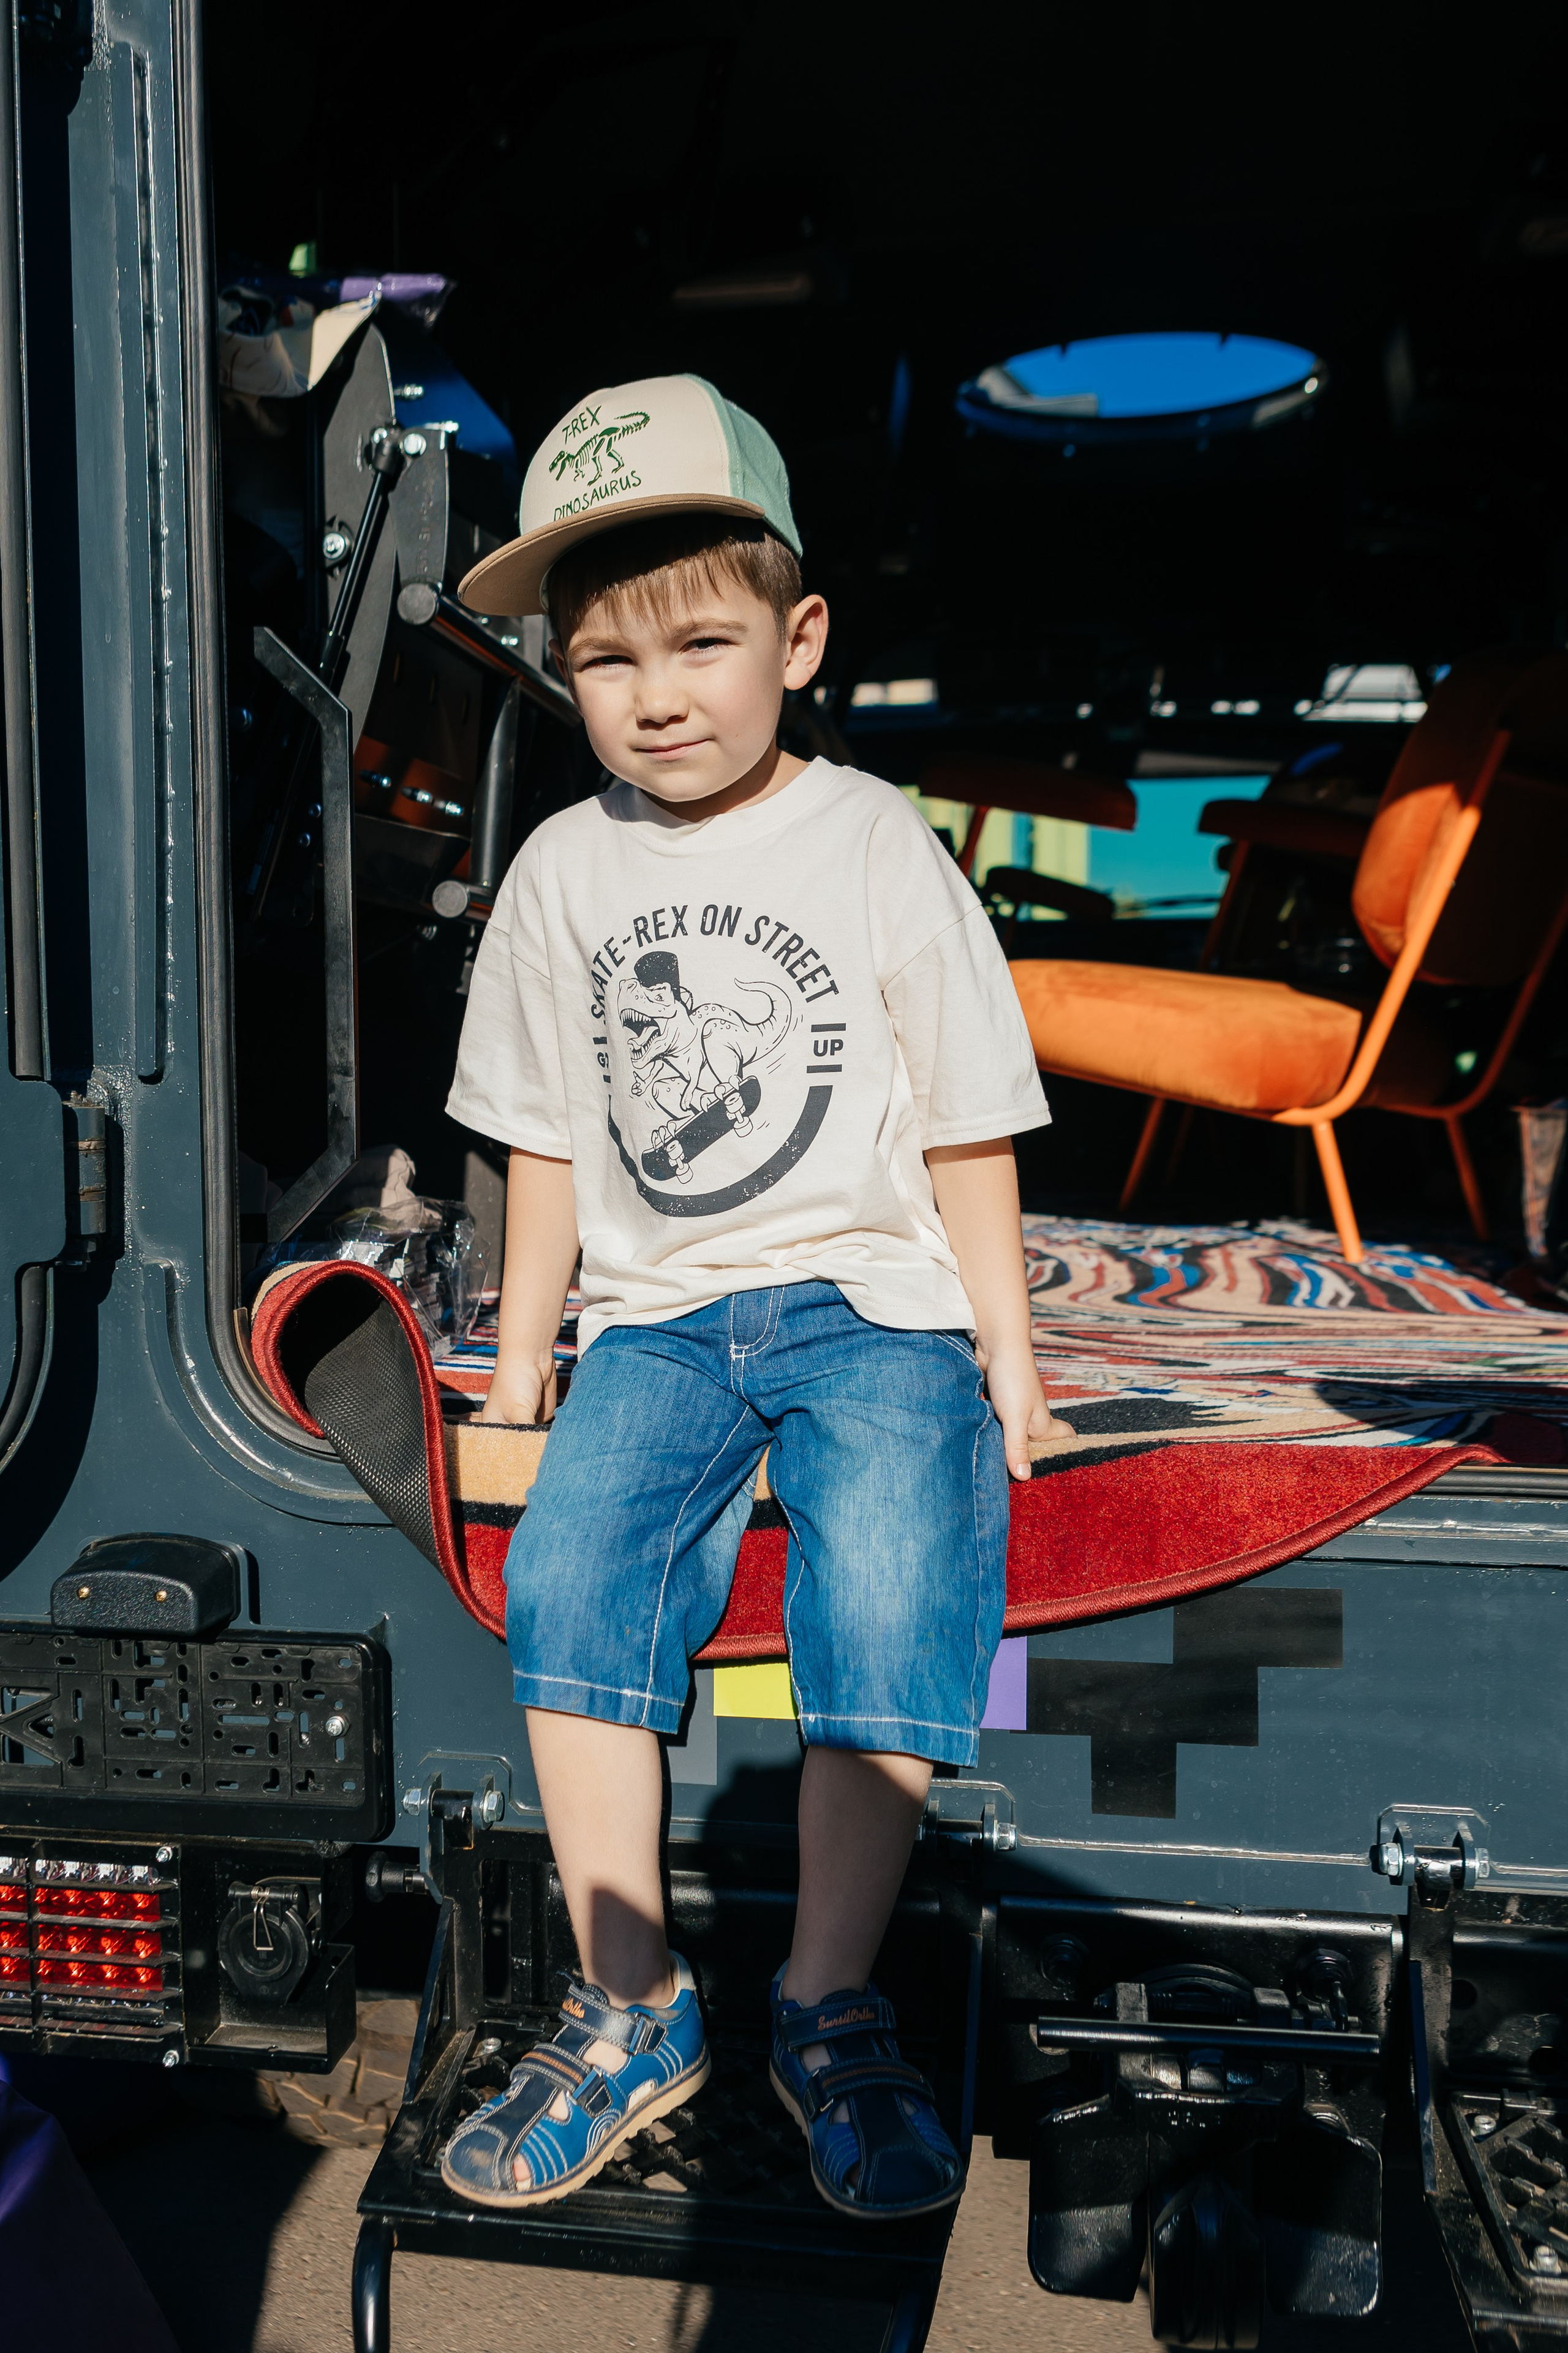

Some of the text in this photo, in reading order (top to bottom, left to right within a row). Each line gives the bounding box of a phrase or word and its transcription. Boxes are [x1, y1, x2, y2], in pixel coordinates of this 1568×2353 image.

[562, 405, 602, 445] T-REX
[553, 470, 642, 521] DINOSAURUS
[590, 904, 840, 1025] SKATE-REX ON STREET
[813, 1039, 844, 1057] UP
